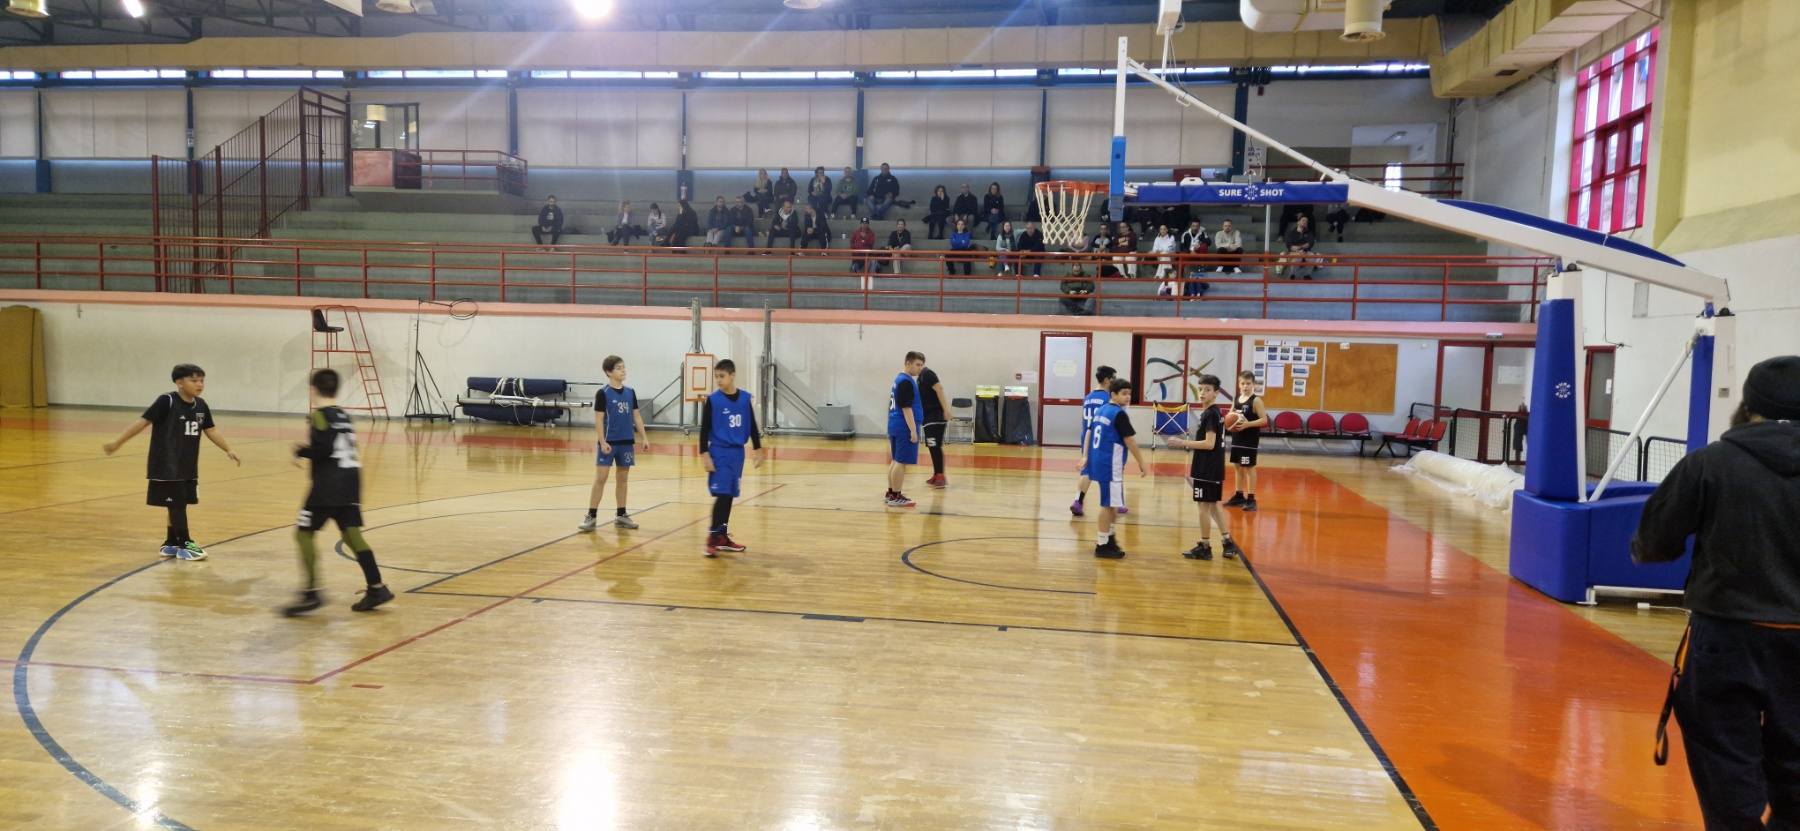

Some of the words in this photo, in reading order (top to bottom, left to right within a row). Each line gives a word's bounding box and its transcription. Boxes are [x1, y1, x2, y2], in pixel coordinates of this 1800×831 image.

[617, 402, 629, 413] 34
[184, 421, 199, 435] 12
[728, 414, 742, 428] 30
[1093, 424, 1102, 449] 6
[1194, 487, 1203, 498] 31
